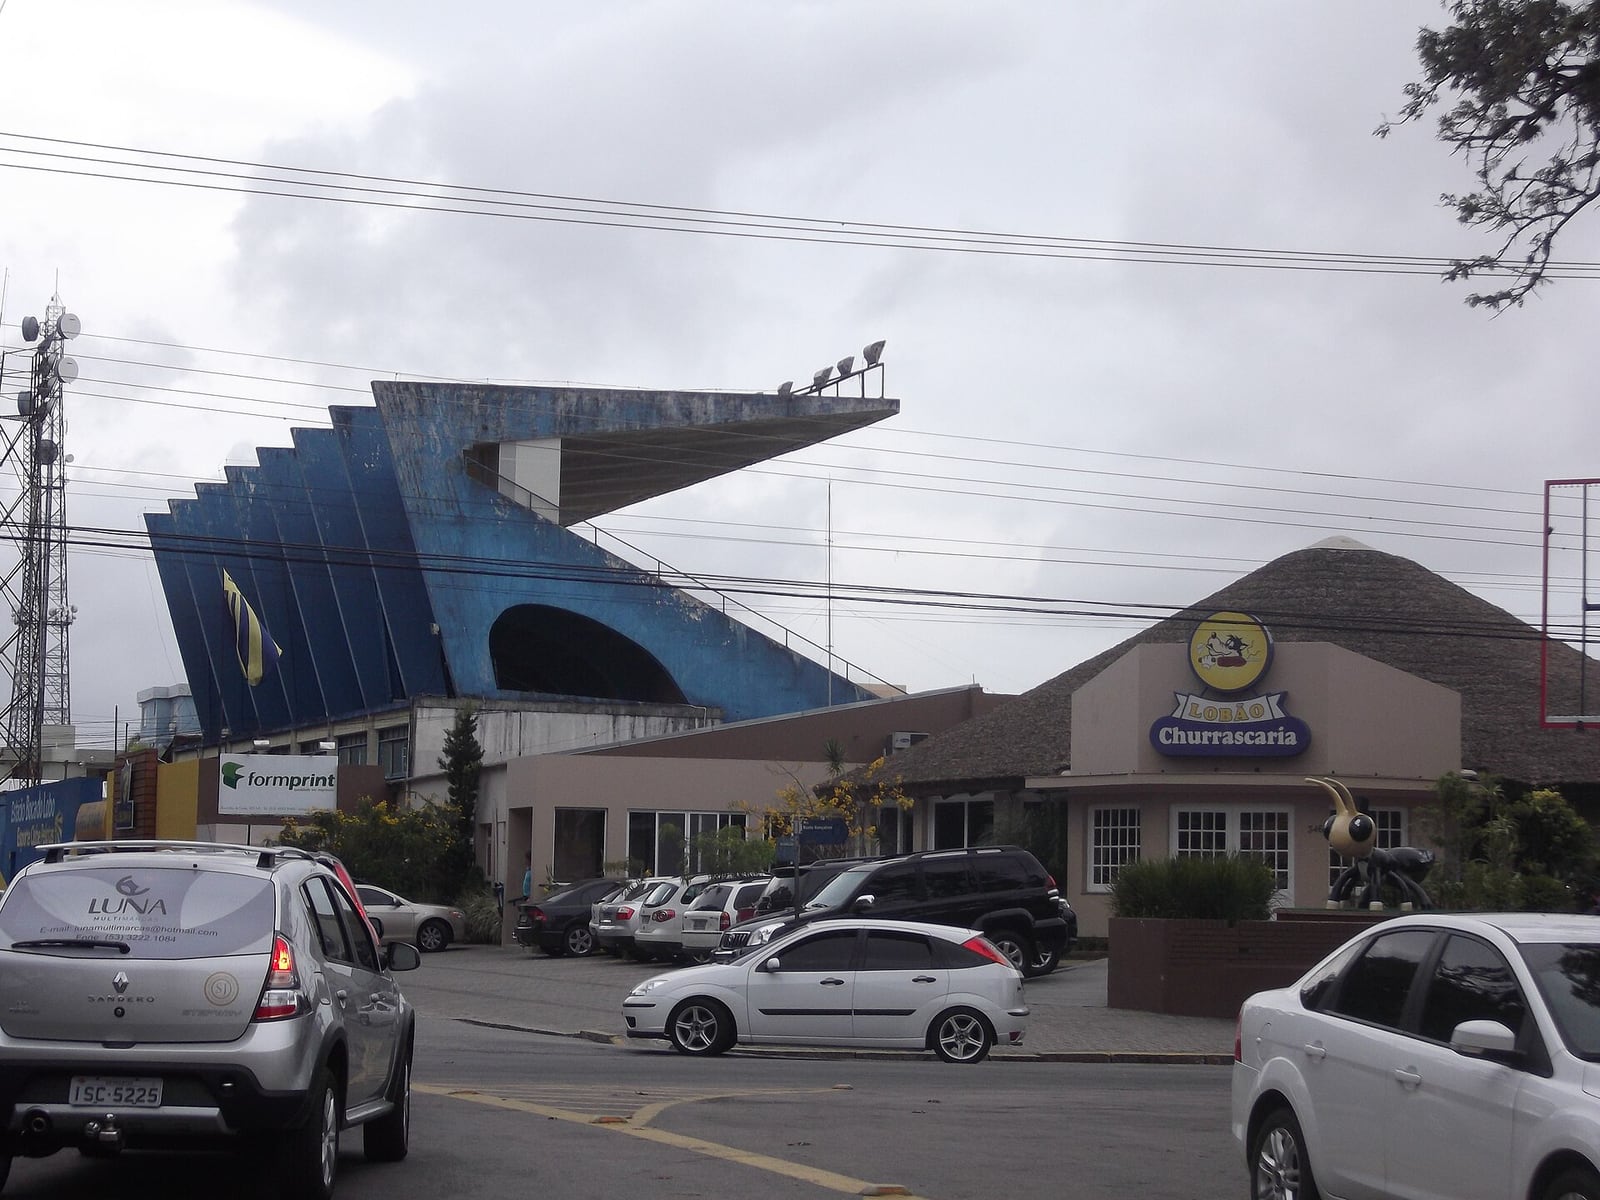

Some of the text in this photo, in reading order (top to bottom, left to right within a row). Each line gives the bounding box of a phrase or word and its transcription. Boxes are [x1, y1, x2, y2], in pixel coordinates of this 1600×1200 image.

[1189, 703, 1265, 722] LOBÃO
[1159, 726, 1298, 746] Churrascaria
[248, 772, 336, 790] formprint
[88, 898, 167, 915] LUNA
